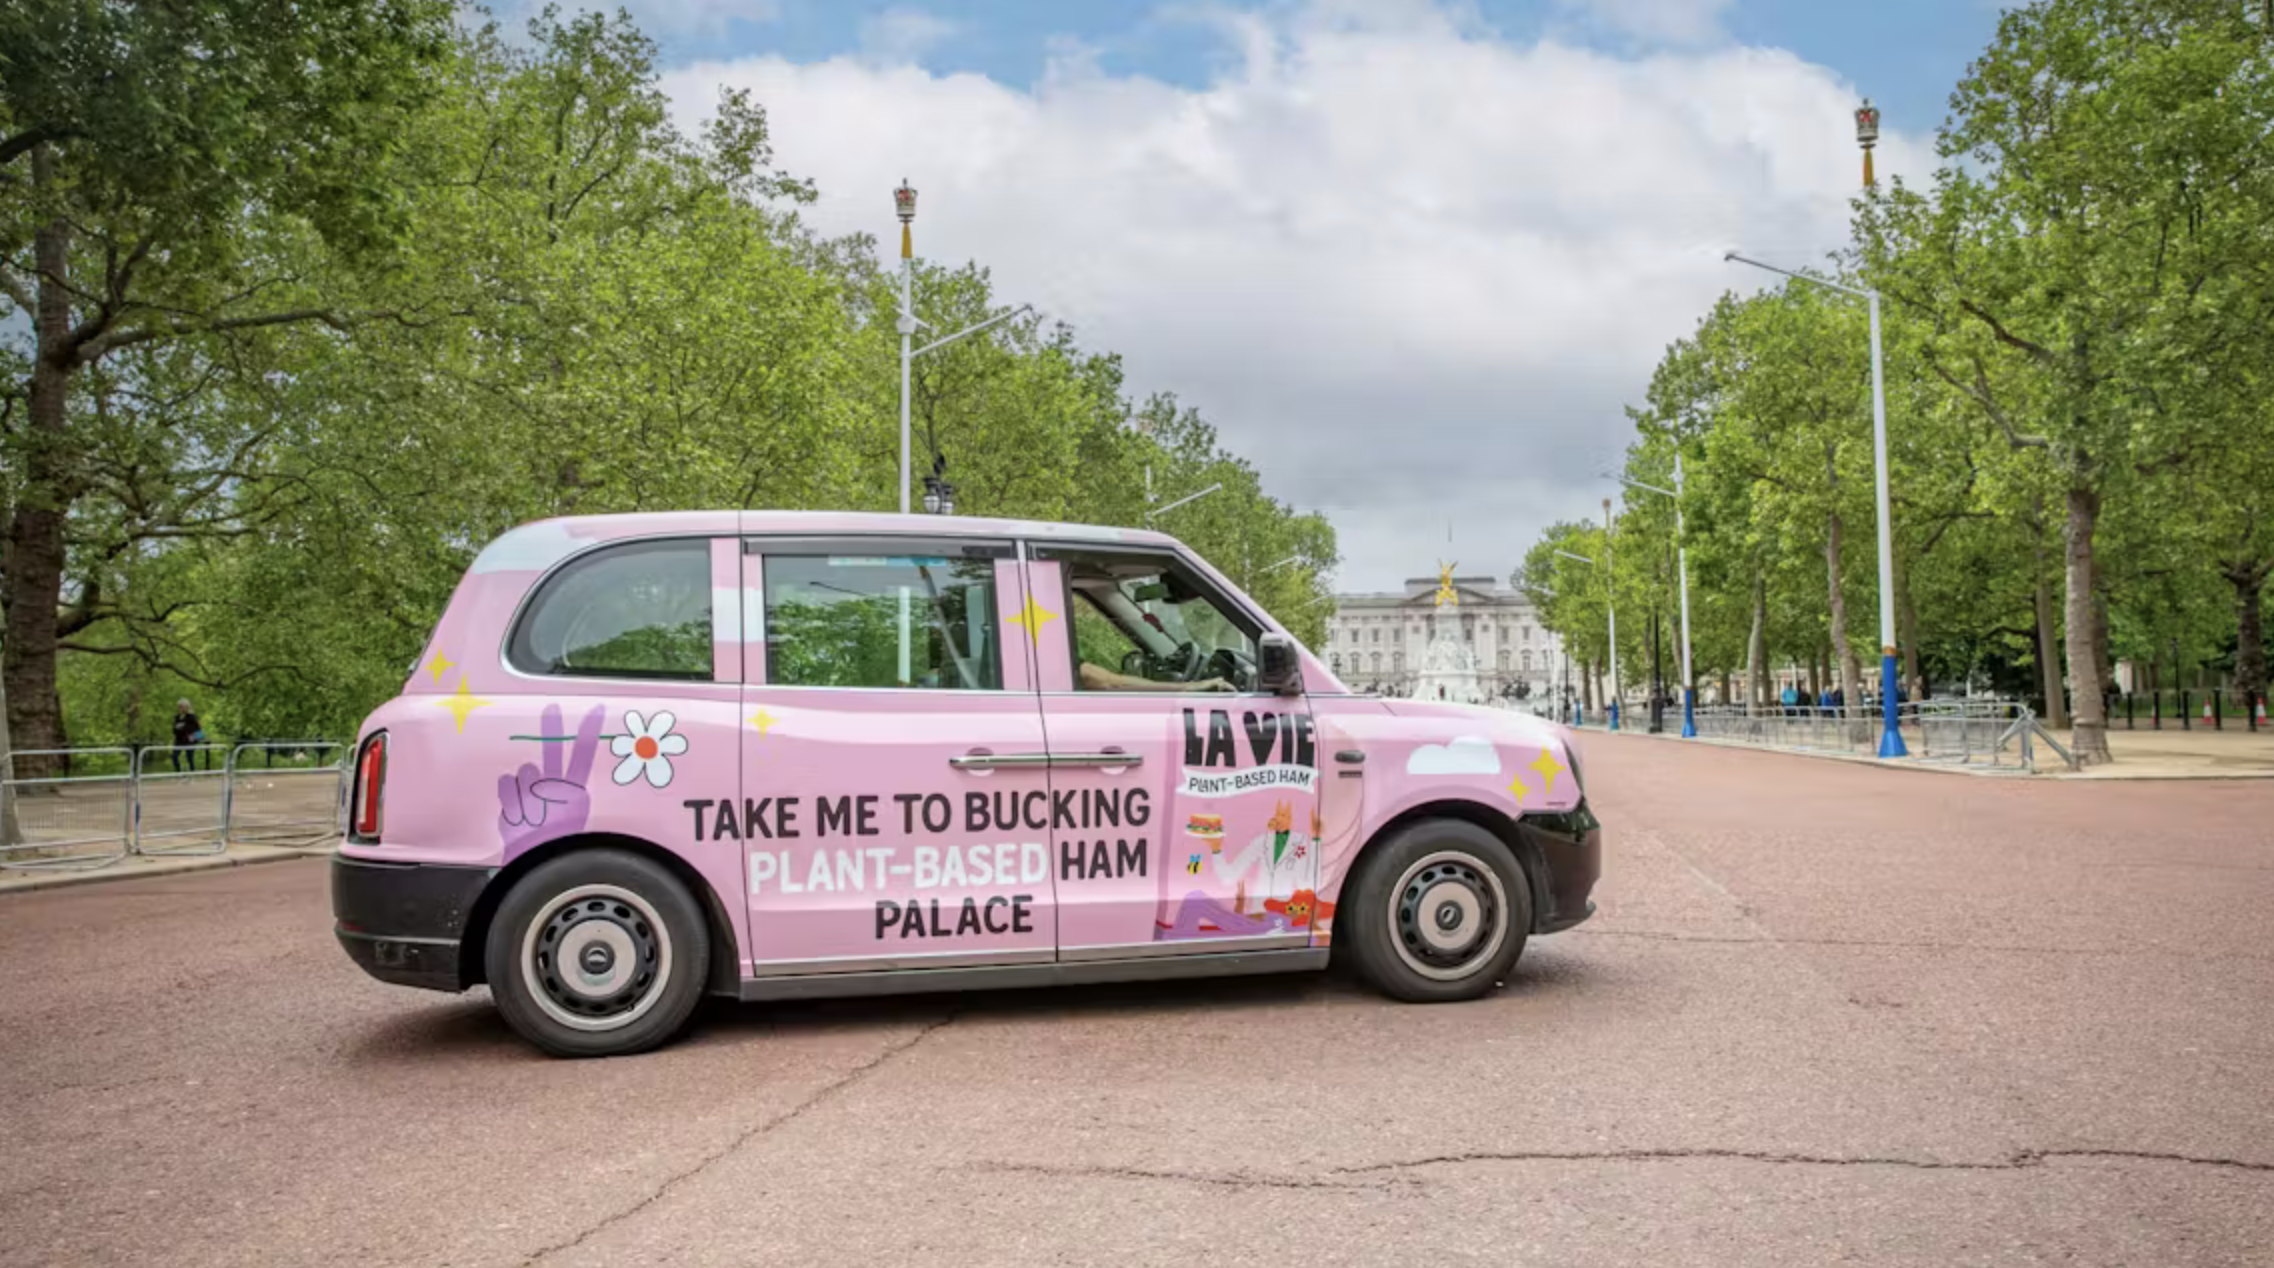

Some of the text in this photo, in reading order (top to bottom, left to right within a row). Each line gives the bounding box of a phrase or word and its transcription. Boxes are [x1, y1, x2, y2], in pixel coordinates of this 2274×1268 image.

[1183, 708, 1315, 768] LA VIE
[1189, 769, 1311, 793] PLANT-BASED HAM
[684, 788, 1150, 841] TAKE ME TO BUCKING
[749, 838, 1147, 893] PLANT-BASED HAM
[875, 895, 1033, 939] PALACE
